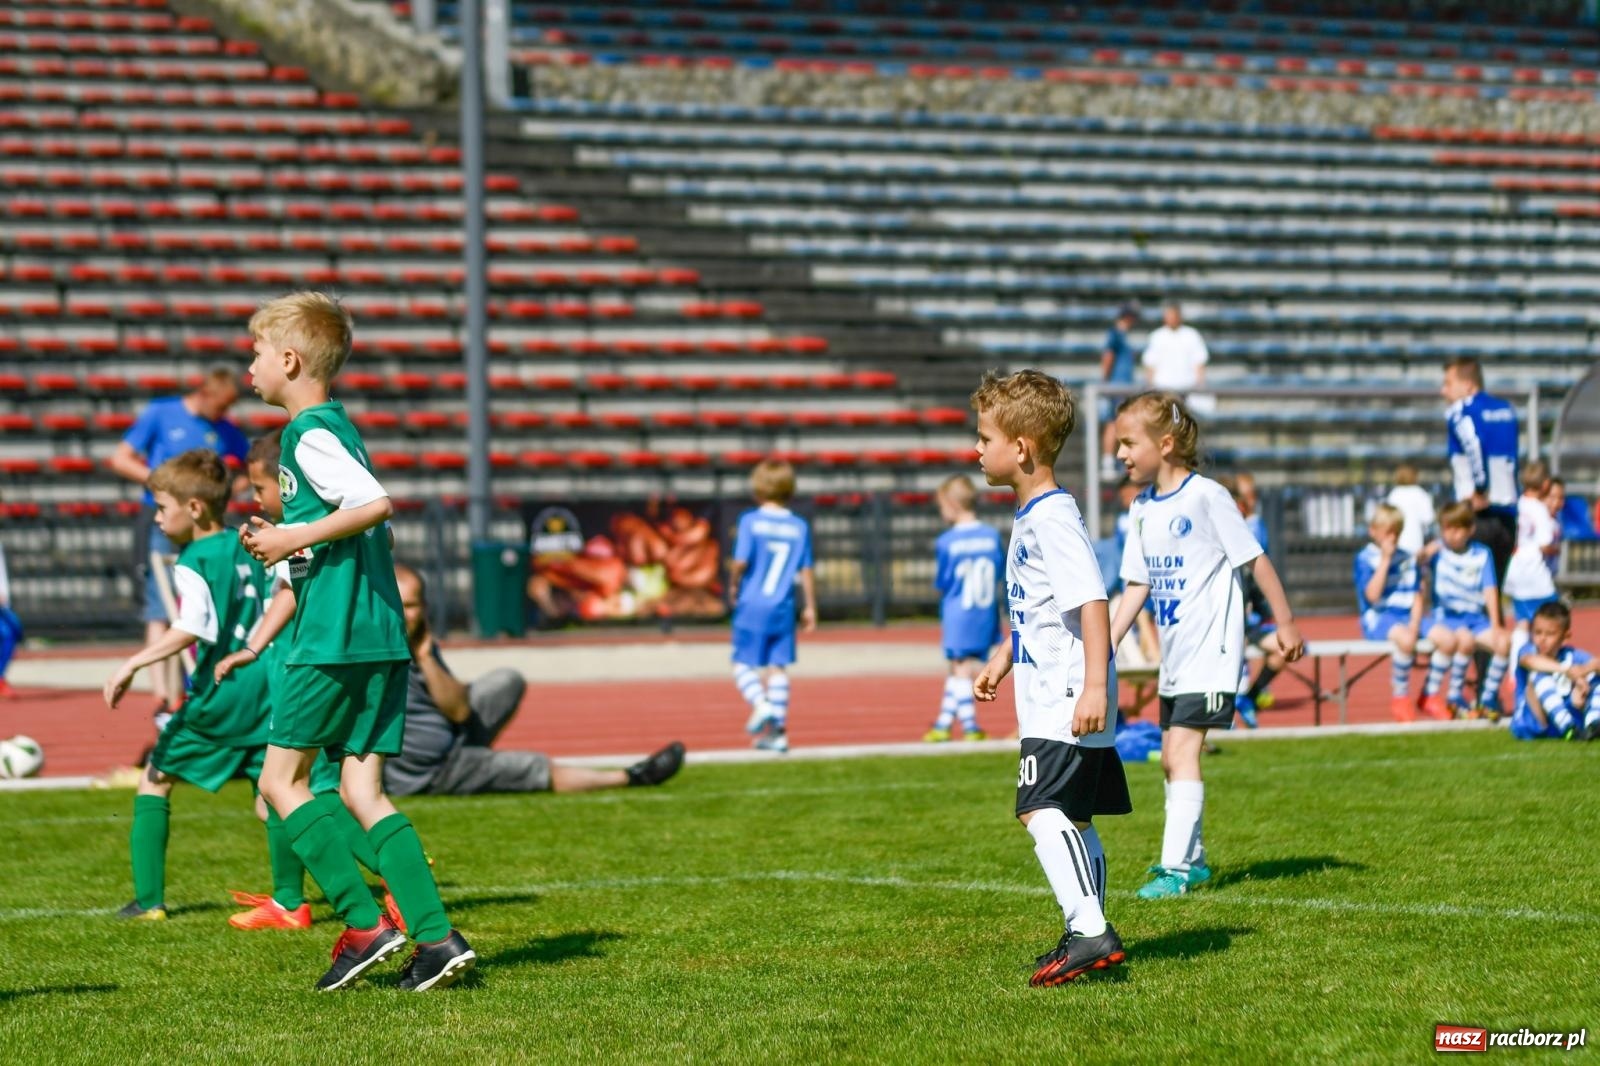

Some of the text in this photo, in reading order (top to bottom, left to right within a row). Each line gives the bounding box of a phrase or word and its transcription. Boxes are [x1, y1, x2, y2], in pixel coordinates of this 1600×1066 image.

[762, 541, 791, 596] 7
[954, 557, 995, 610] 10
[1017, 755, 1037, 788] 30
